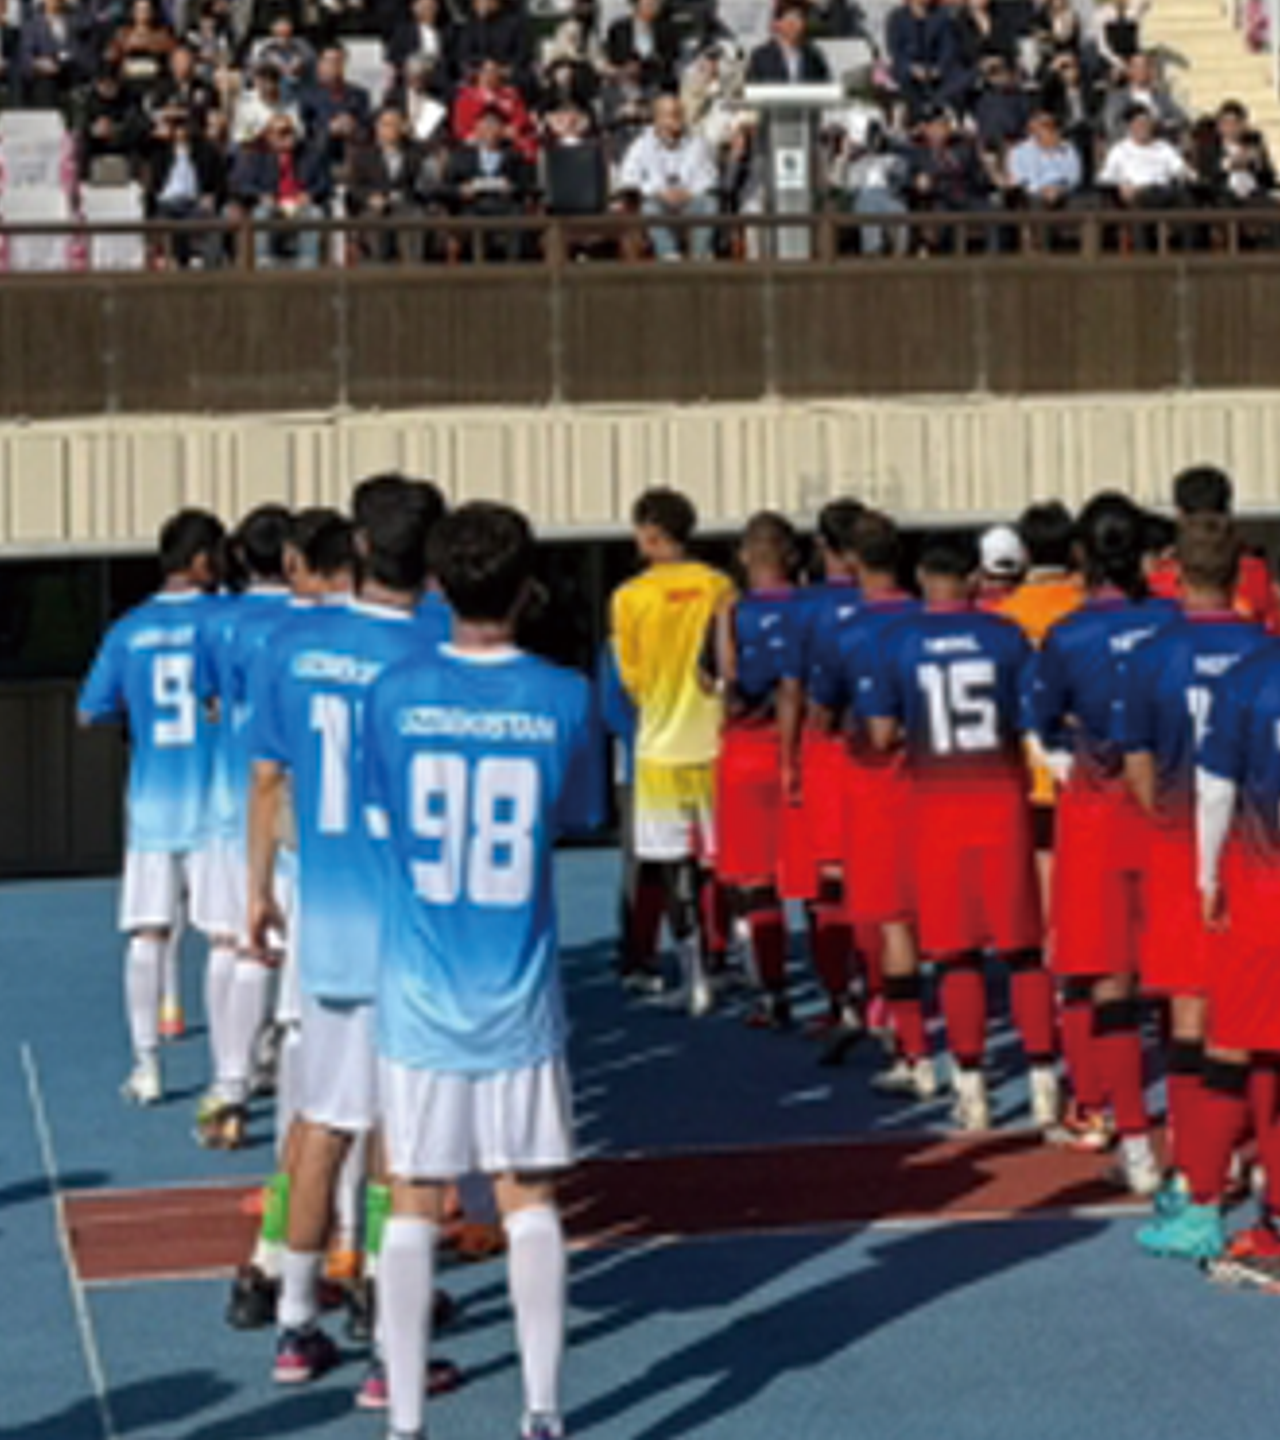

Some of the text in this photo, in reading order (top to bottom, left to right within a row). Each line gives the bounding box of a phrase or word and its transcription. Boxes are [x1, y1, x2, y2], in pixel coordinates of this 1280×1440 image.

[154, 653, 196, 747] 9
[917, 660, 998, 752] 15
[411, 750, 541, 905] 98
